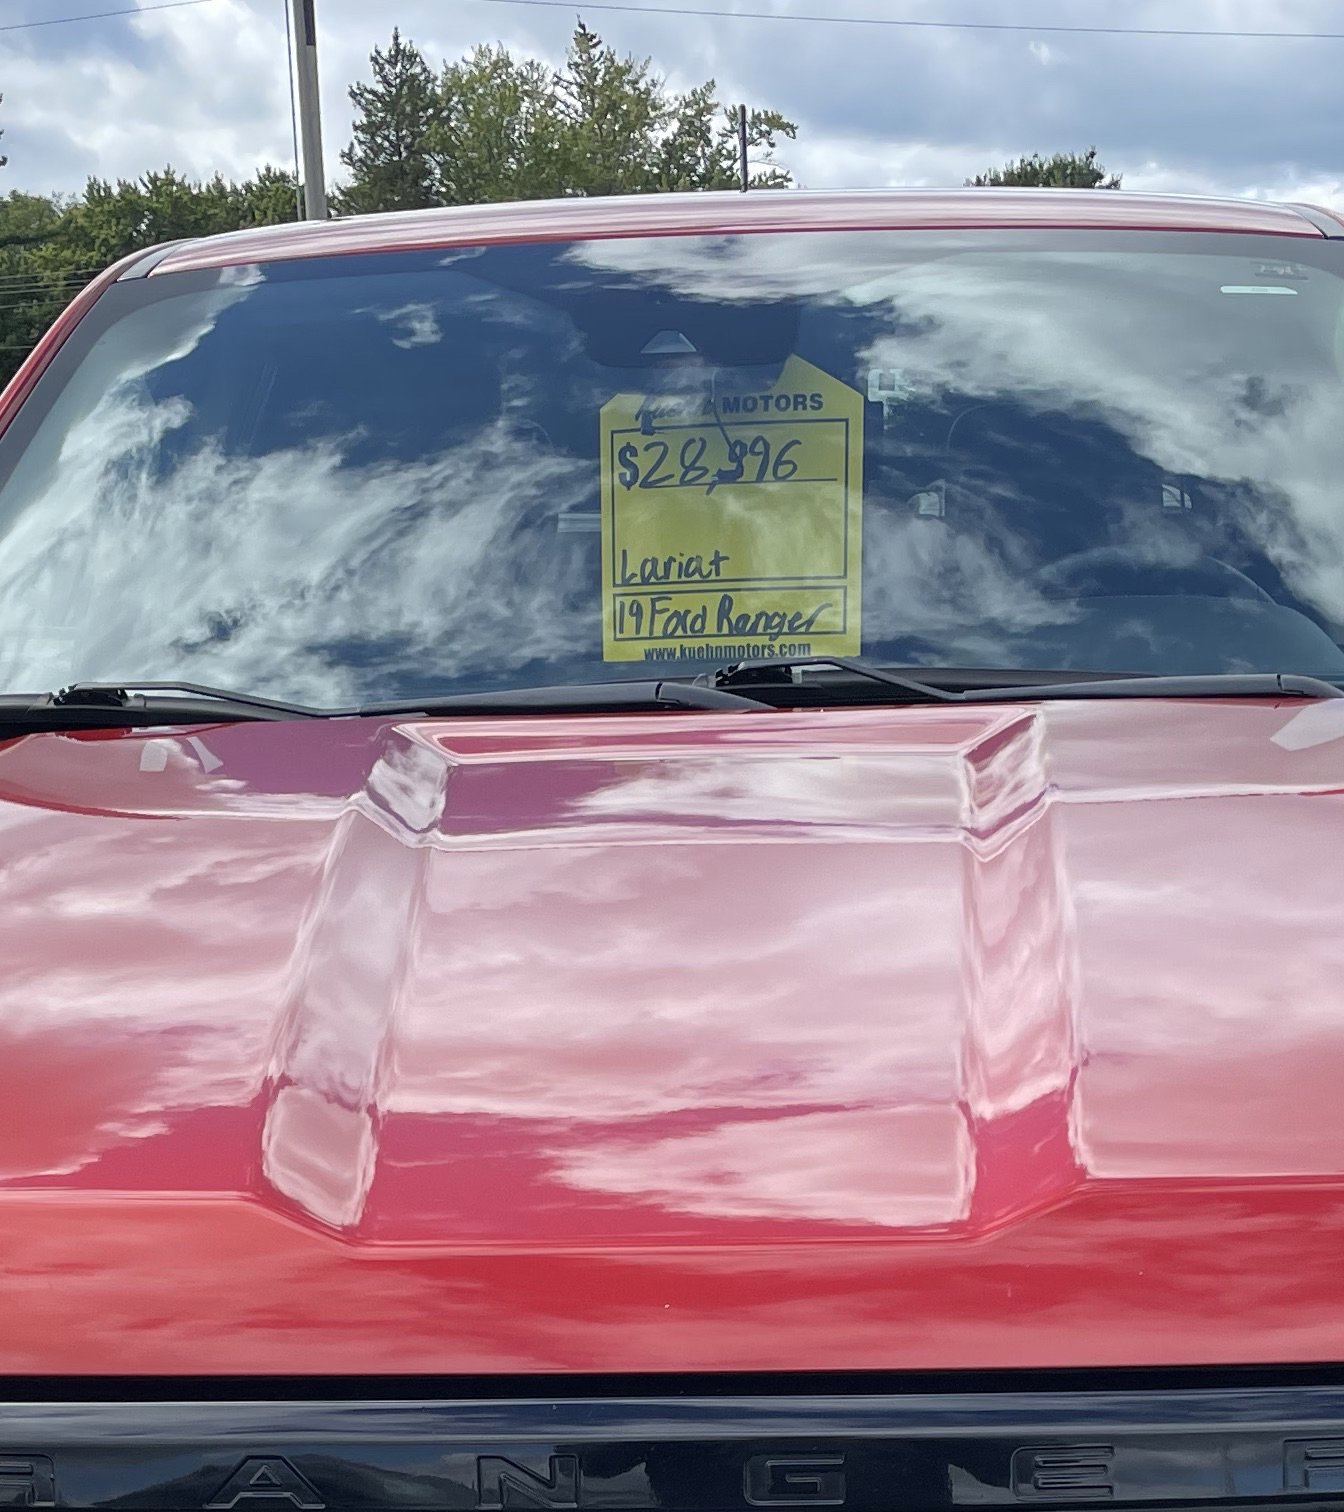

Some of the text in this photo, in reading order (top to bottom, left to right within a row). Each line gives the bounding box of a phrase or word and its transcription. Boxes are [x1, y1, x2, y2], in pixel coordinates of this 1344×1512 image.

[722, 393, 824, 414] MOTORS
[621, 549, 729, 585] Lariat
[618, 593, 833, 641] 19 Ford Ranger
[643, 643, 811, 661] www.kuehnmotors.com
